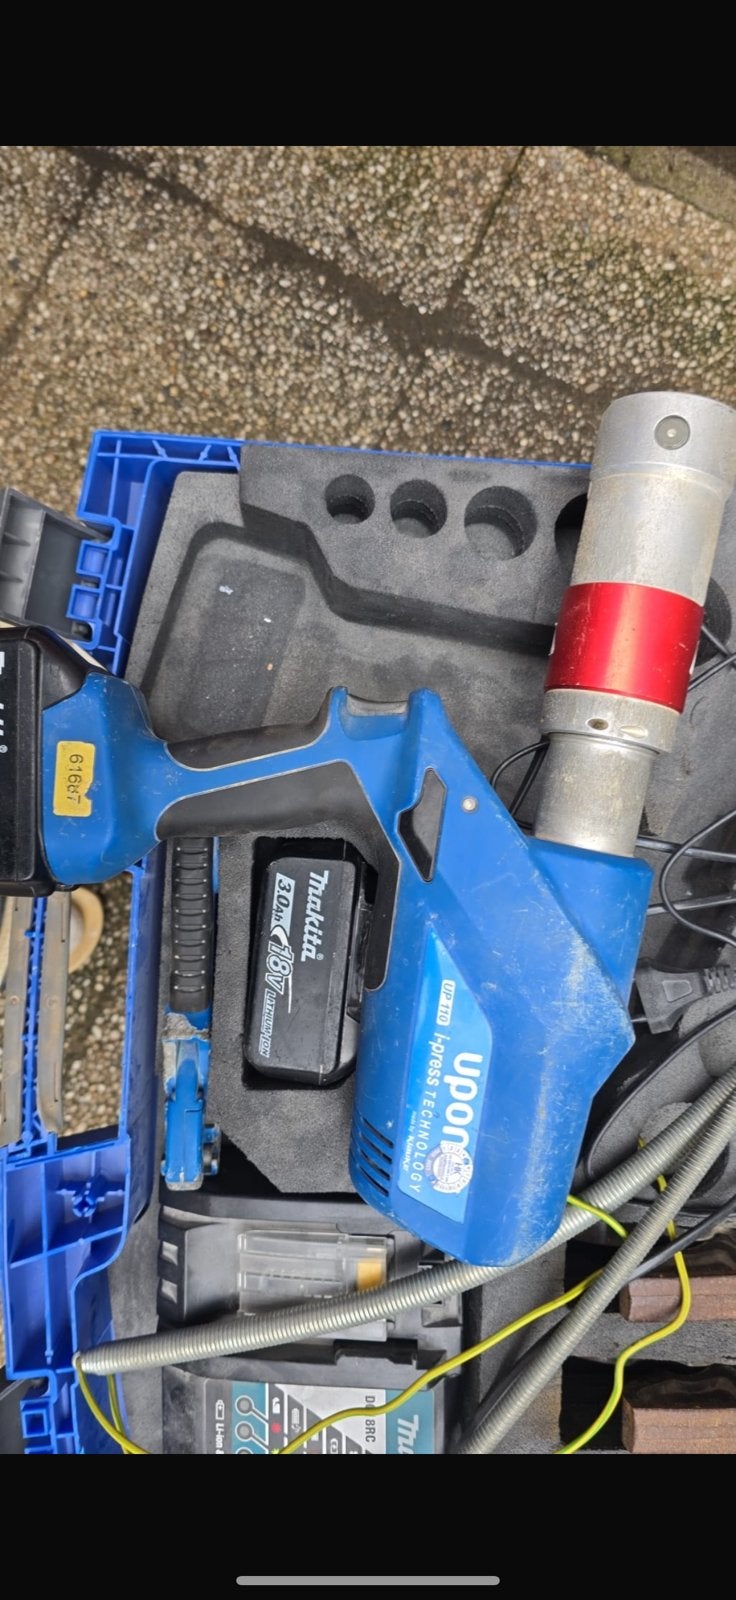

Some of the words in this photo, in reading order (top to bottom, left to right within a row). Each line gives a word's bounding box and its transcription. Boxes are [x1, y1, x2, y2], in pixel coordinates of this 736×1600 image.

[271, 877, 292, 922] 3.0Ah
[265, 941, 294, 995] 18V
[443, 982, 454, 1001] UP
[438, 1003, 451, 1023] 110
[426, 1032, 451, 1087] i-press
[408, 1089, 437, 1193] TECHNOLOGY
